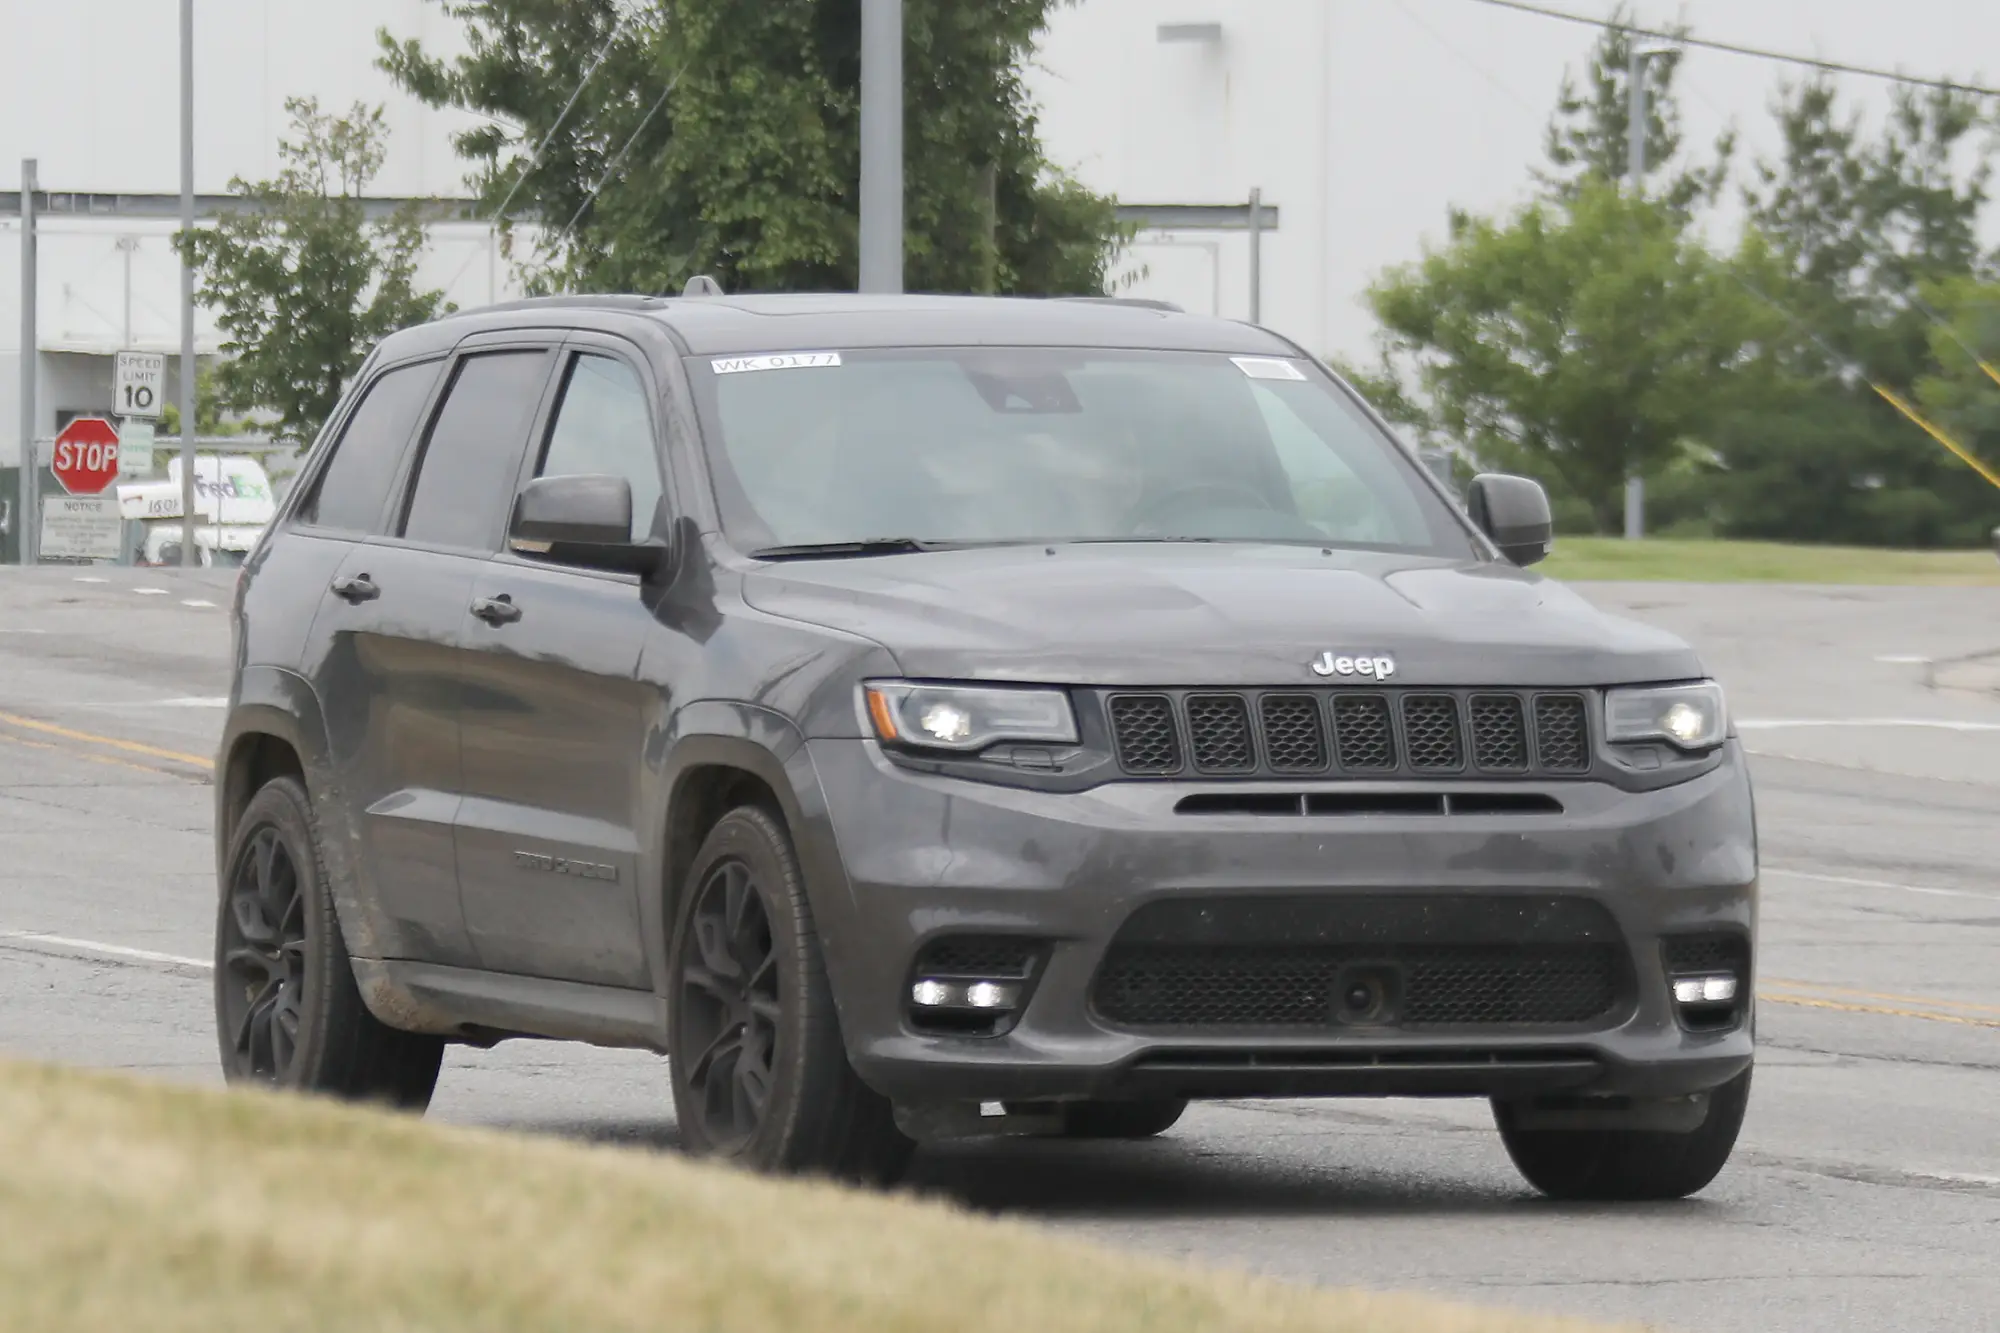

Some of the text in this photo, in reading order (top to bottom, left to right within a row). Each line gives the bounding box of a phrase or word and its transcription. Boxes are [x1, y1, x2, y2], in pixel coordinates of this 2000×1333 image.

[120, 357, 161, 369] SPEED
[717, 355, 835, 372] WK 0177
[123, 371, 157, 382] LIMIT
[125, 385, 153, 409] 10
[56, 441, 117, 472] STOP
[64, 501, 104, 512] NOTICE
[1313, 652, 1394, 681] Jeep
